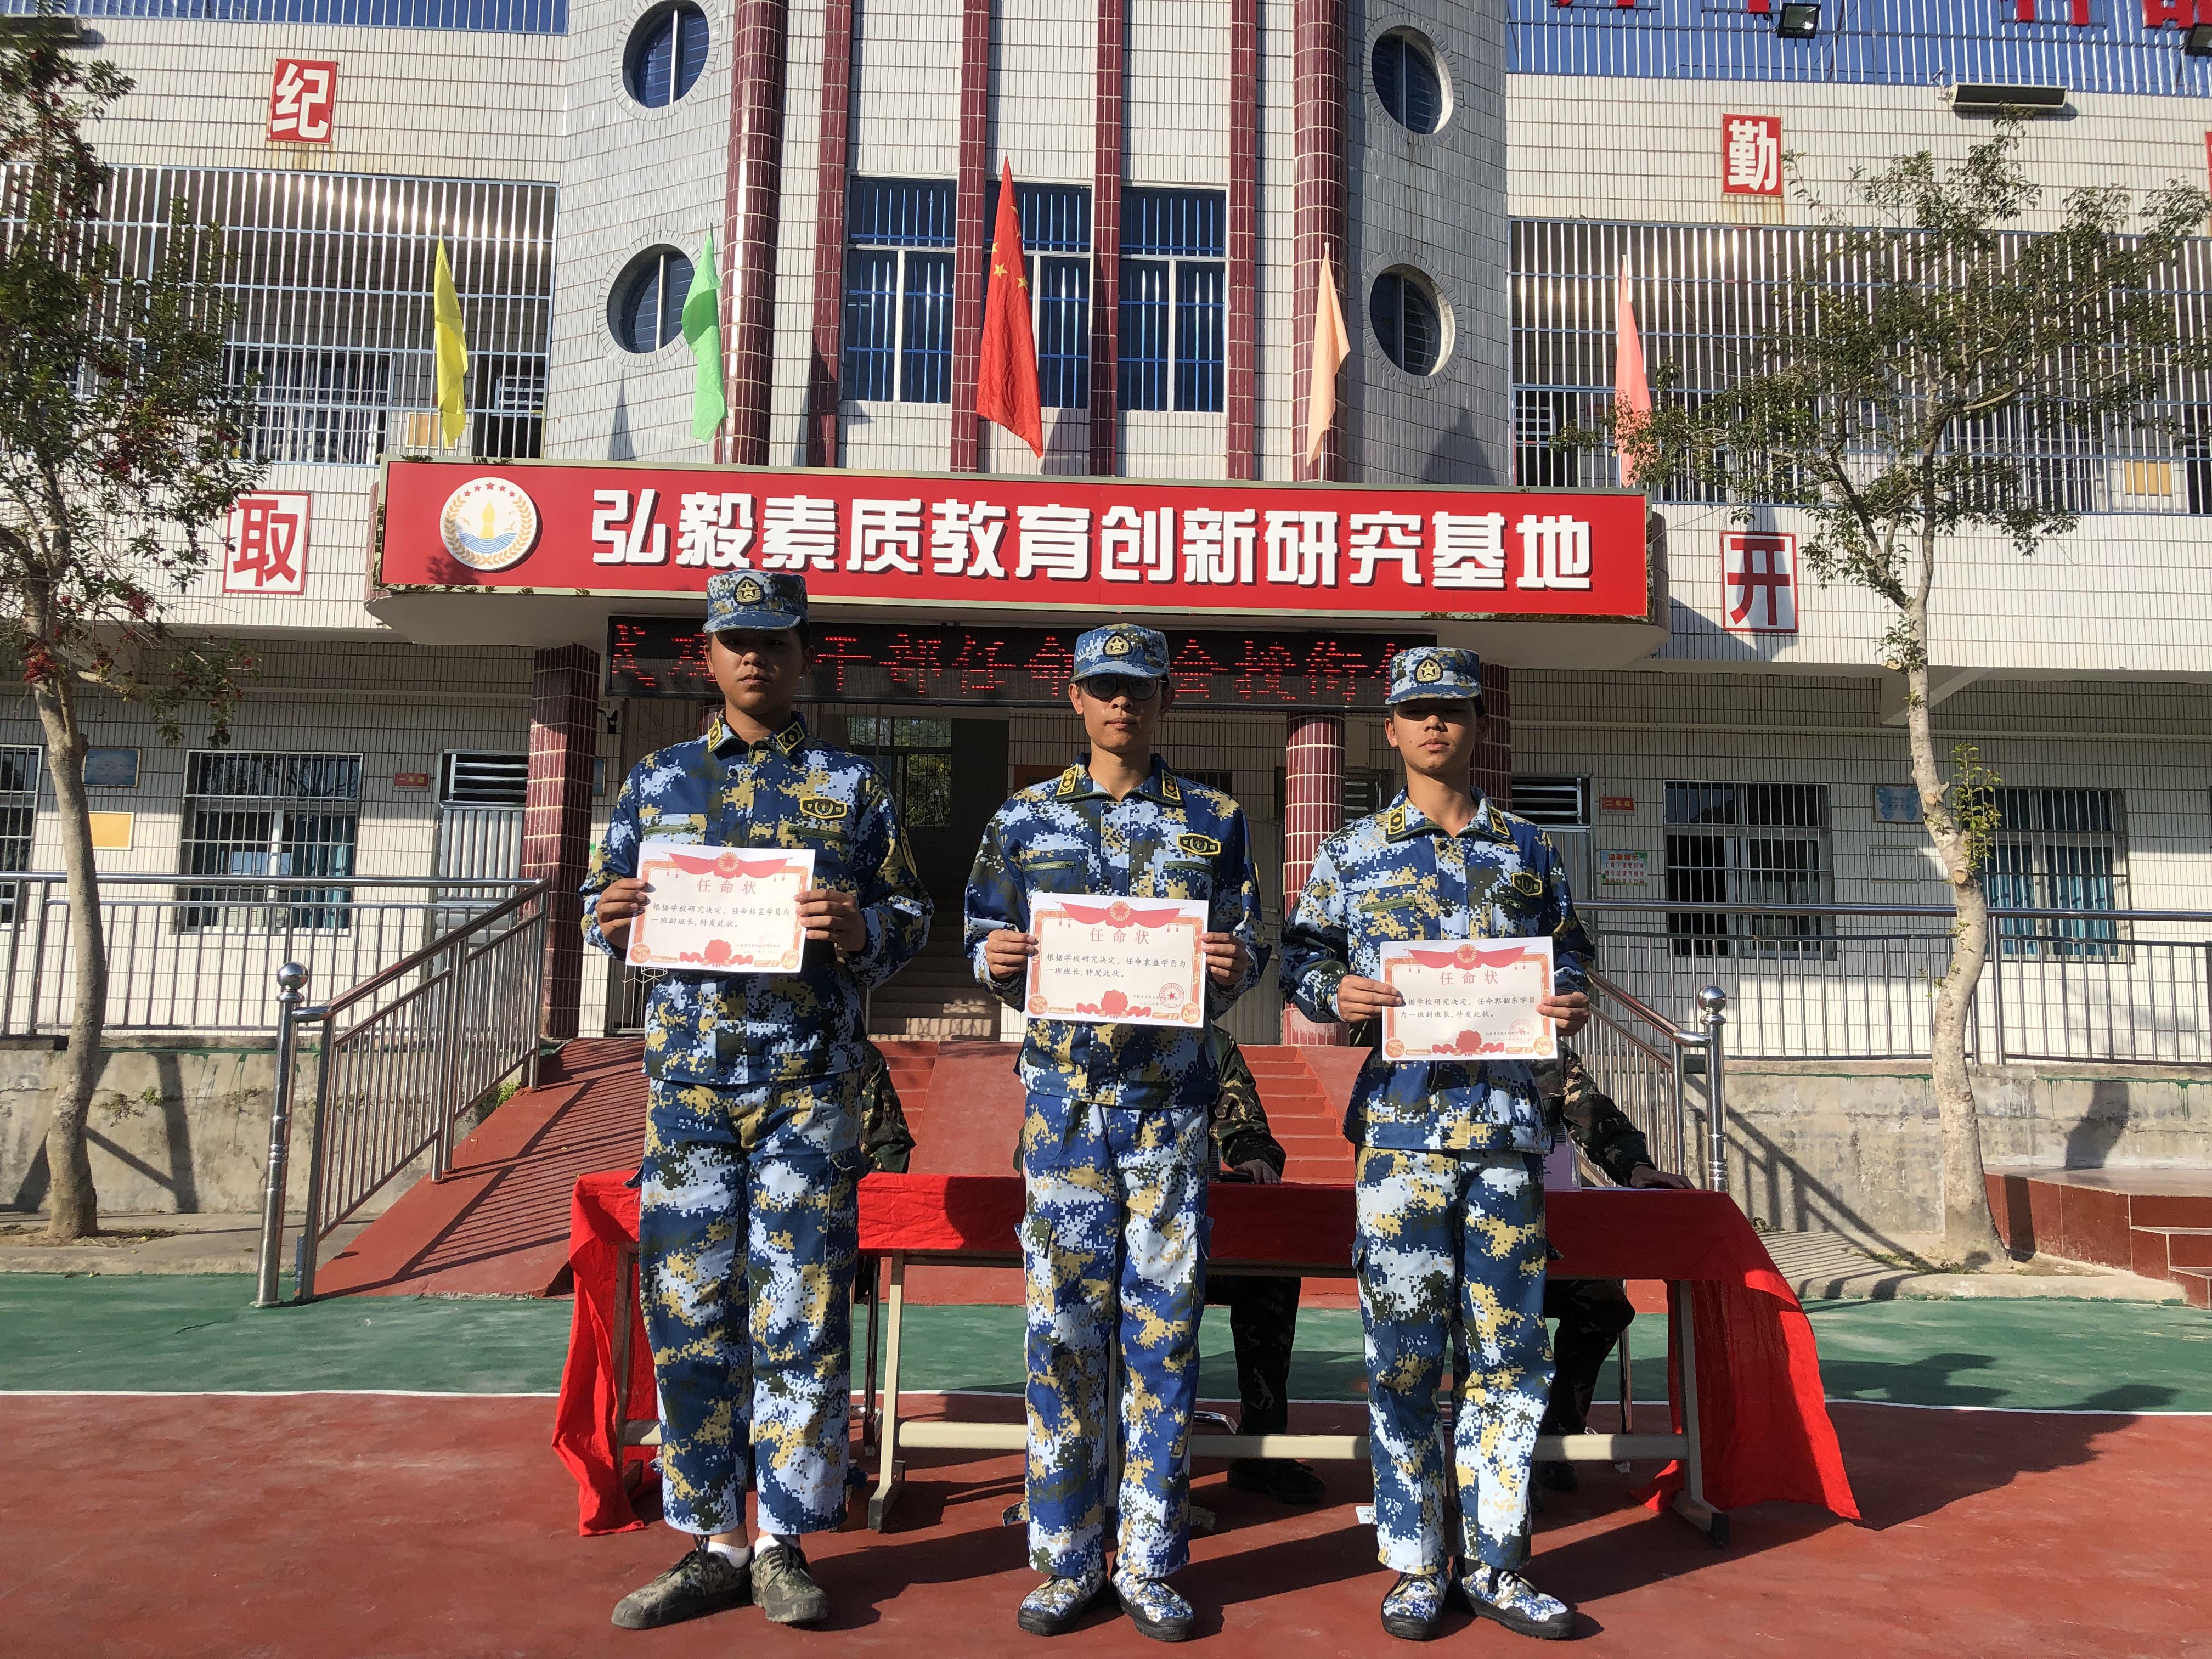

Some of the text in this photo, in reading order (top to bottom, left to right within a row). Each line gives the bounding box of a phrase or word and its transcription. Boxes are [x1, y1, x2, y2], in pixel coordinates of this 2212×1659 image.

[272, 62, 330, 140] 纪
[1728, 119, 1776, 192] 勤
[232, 498, 298, 588] 取
[592, 487, 1594, 591] 弘毅素质教育创新研究基地
[1726, 538, 1790, 626] 开
[697, 878, 757, 894] 任命状
[1090, 928, 1150, 944] 任命状
[1440, 970, 1499, 985] 任命状
